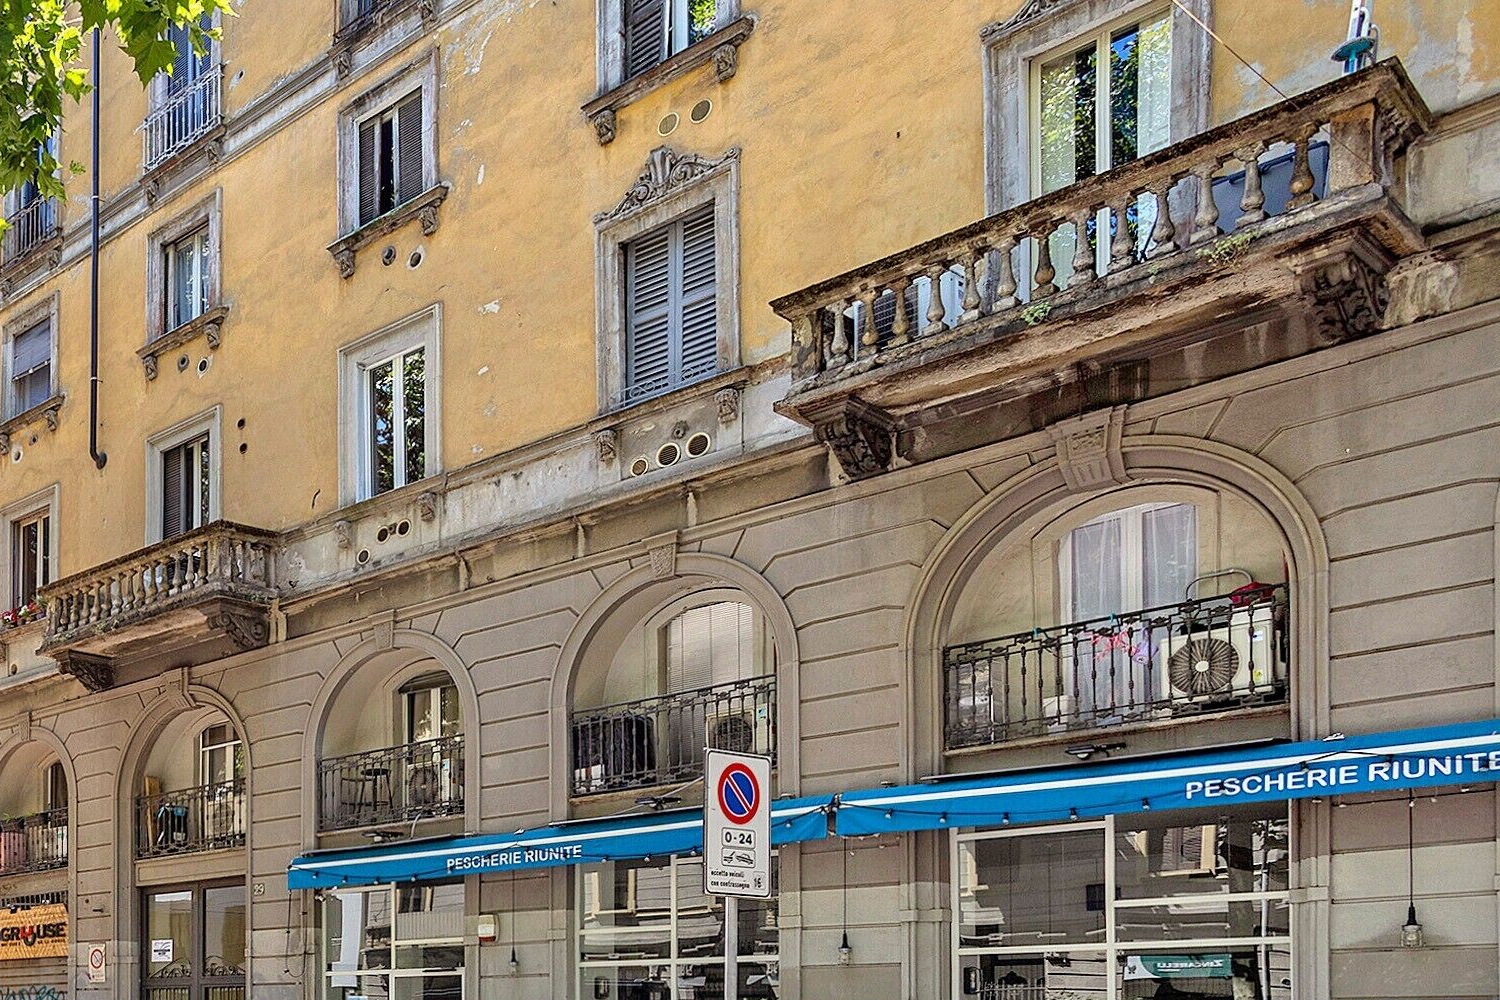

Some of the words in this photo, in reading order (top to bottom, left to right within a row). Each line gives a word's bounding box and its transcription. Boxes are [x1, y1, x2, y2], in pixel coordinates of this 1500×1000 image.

[1185, 764, 1358, 800] PESCHERIE
[1367, 750, 1500, 782] RIUNITE
[446, 850, 522, 870] PESCHERIE
[524, 844, 582, 863] RIUNITE
[253, 884, 264, 896] 29
